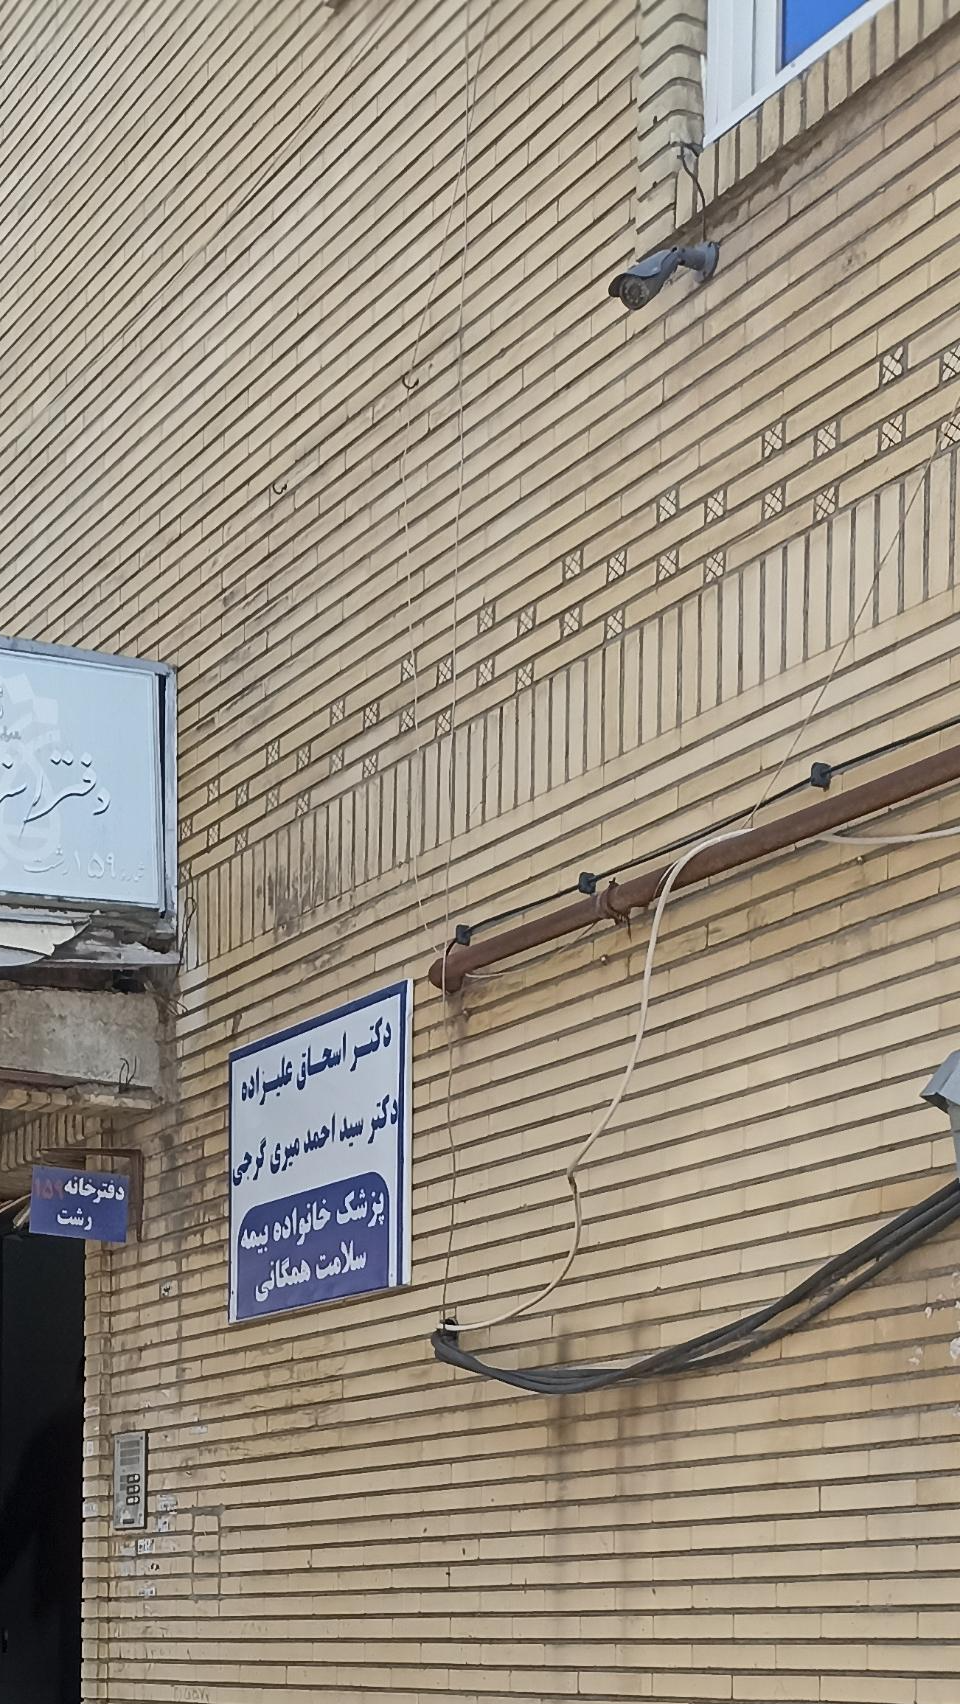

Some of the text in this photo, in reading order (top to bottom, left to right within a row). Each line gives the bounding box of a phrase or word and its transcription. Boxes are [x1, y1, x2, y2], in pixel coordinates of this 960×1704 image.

[24, 751, 111, 823] دفتر
[23, 846, 71, 876] رشت
[74, 850, 117, 879] ۱۵۹
[241, 1016, 391, 1106] دکتر اسحاق علیزاده
[232, 1094, 398, 1186] دکتر سید احمد میری گرجی
[56, 1207, 93, 1231] رشت
[64, 1176, 125, 1203] دفترخانه
[240, 1188, 385, 1254] پزشک خانواده بیمه
[255, 1239, 367, 1302] سلامت همگانی
